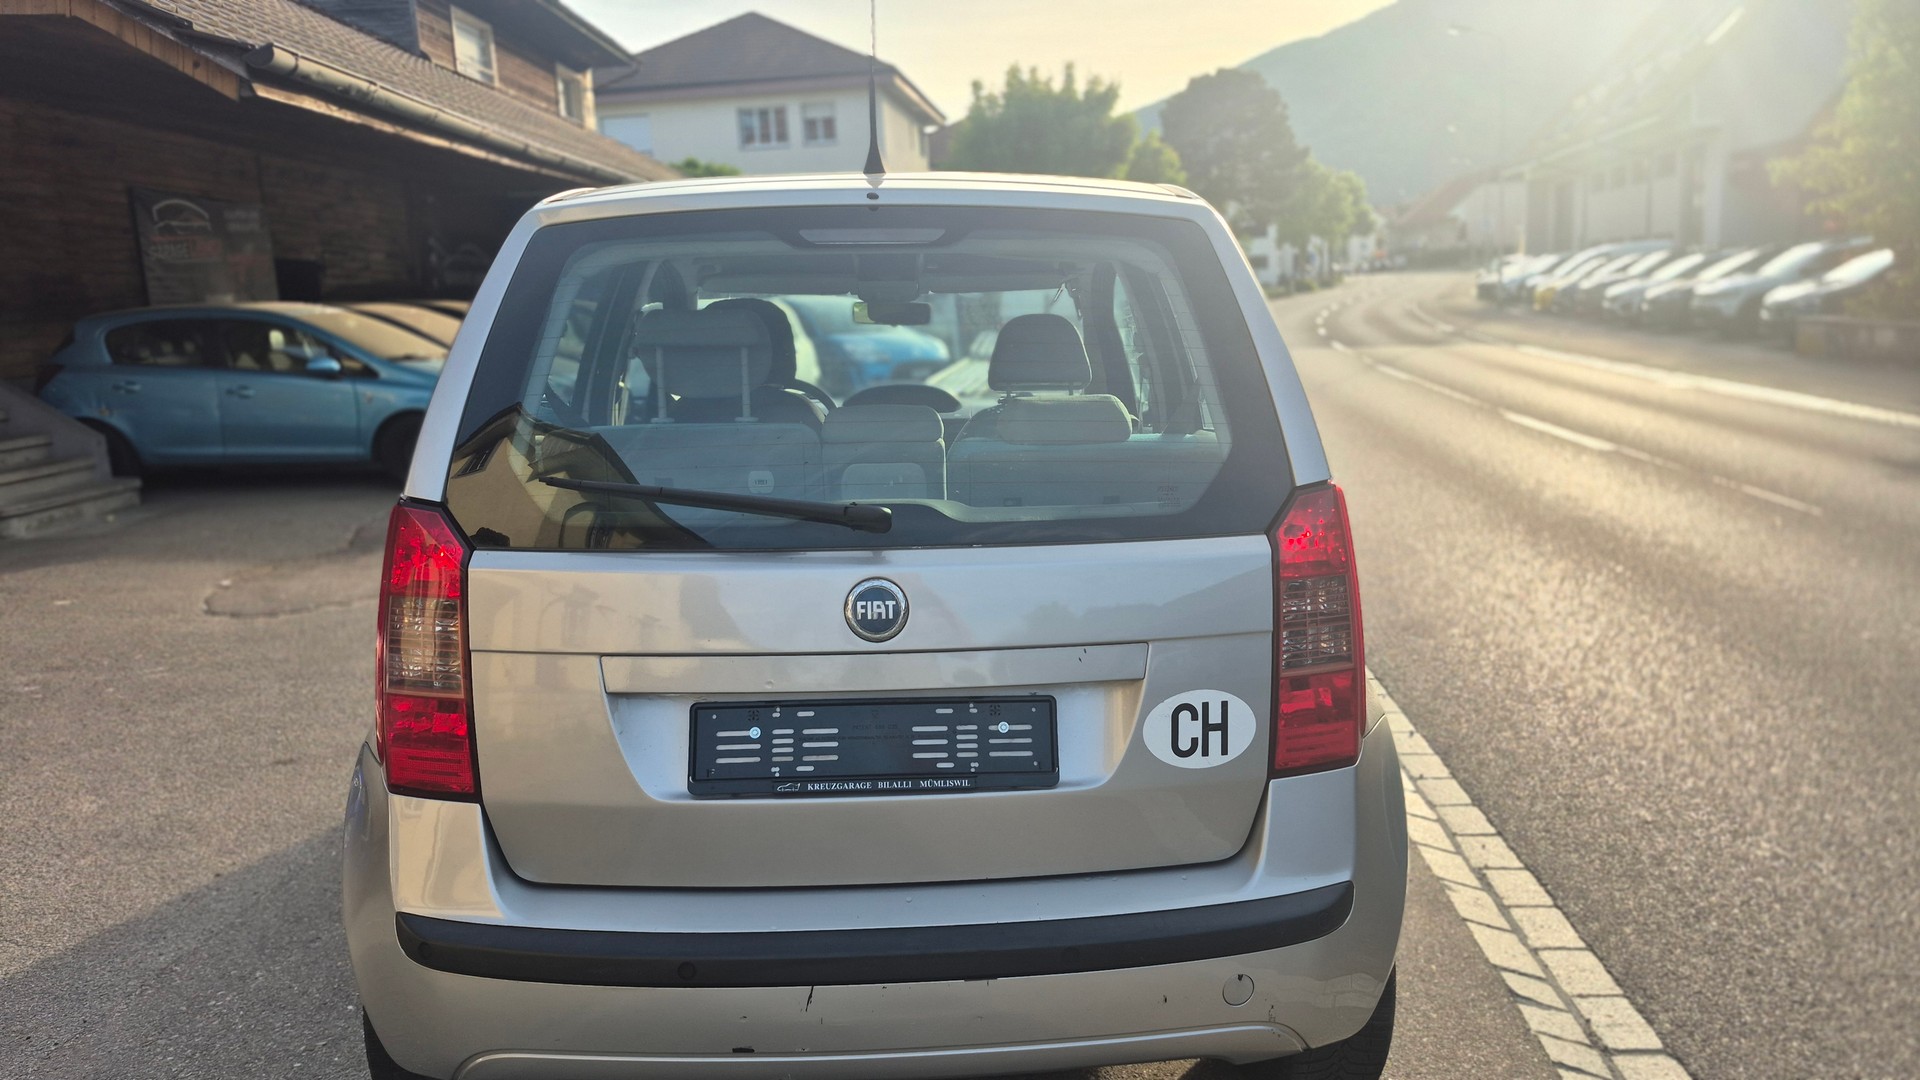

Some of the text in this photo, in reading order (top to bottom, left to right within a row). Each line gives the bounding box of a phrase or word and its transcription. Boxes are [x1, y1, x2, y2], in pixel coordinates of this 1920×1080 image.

[857, 601, 896, 620] FIAT
[1171, 701, 1228, 758] CH
[807, 779, 971, 791] KREUZGARAGE BILALLI MÜMLISWIL
